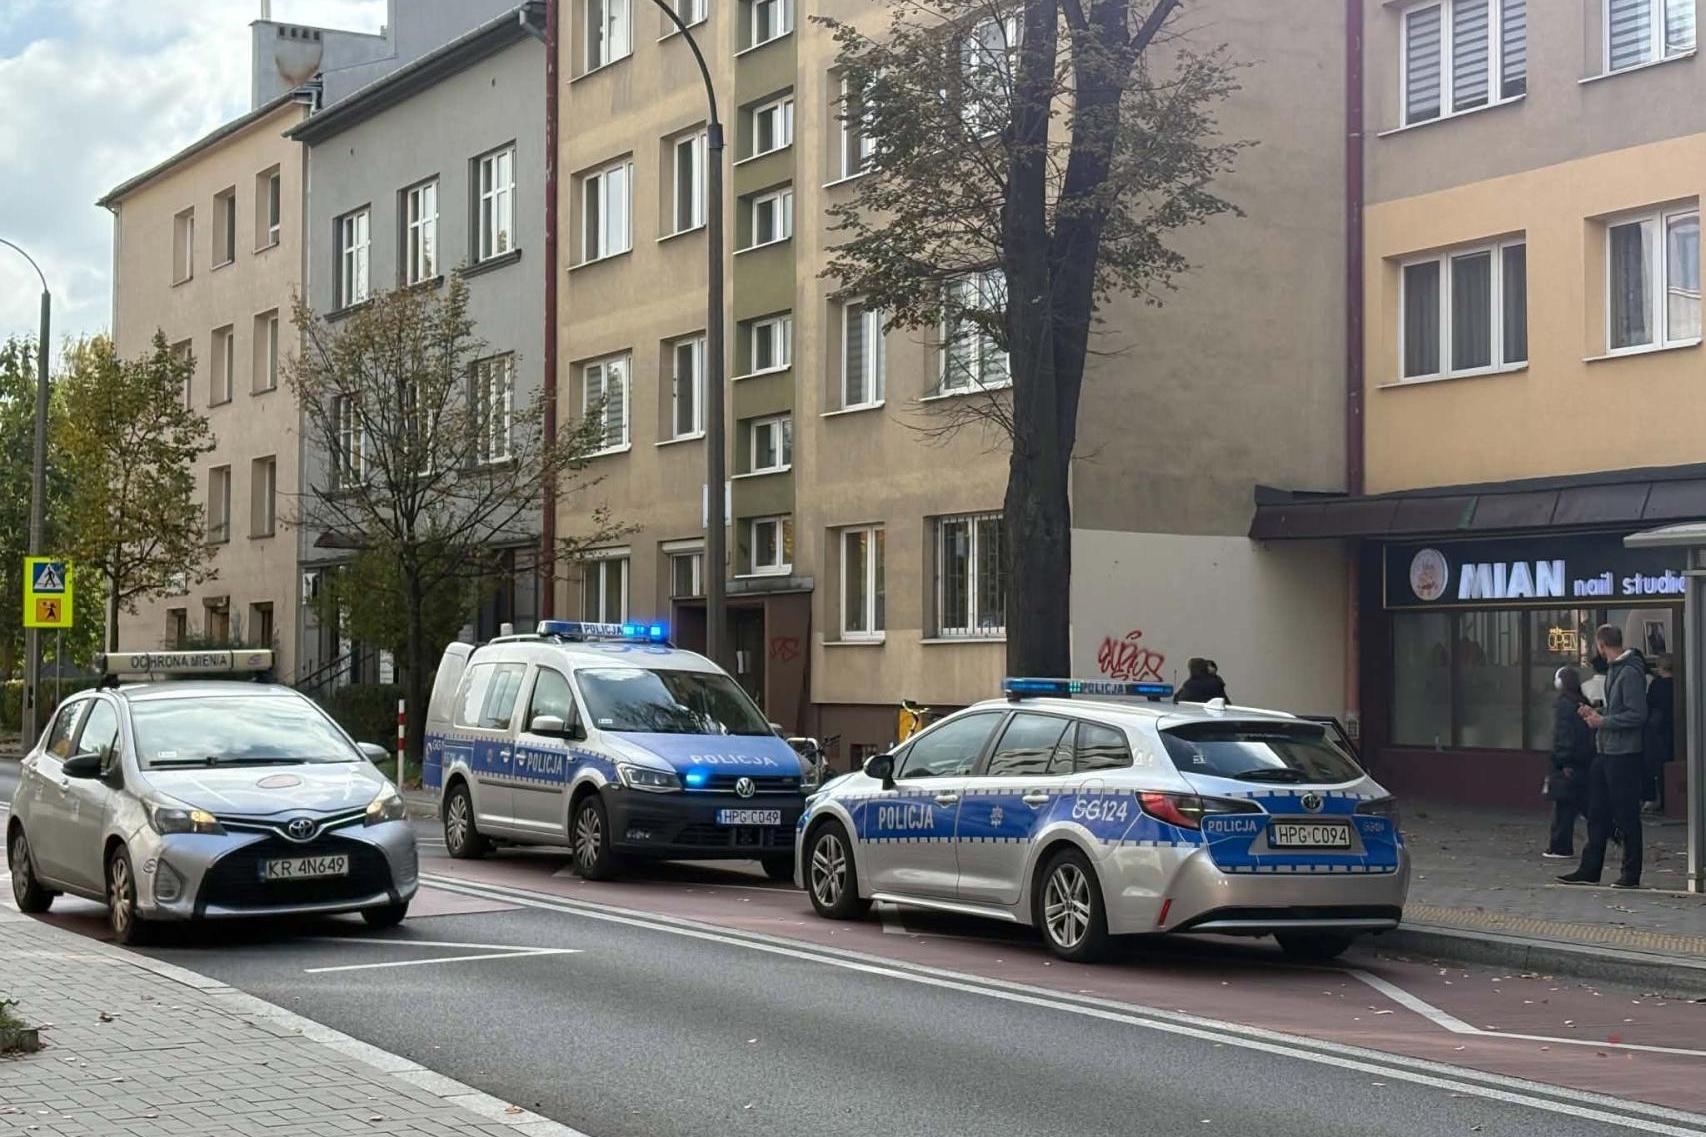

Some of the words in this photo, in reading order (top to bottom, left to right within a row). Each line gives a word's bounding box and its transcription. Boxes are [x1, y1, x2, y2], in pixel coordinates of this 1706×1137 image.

[1458, 559, 1565, 600] MIAN
[1573, 571, 1614, 597] nail
[582, 623, 624, 635] POLICJA
[1548, 634, 1577, 650] OPEN
[130, 655, 190, 670] OCHRONA
[1081, 682, 1124, 695] POLICJA
[526, 751, 563, 774] POLICJA
[689, 754, 778, 767] POLICJA
[724, 810, 748, 824] HPG
[879, 804, 934, 830] POLICJA
[1207, 819, 1258, 833] POLICJA
[1278, 826, 1308, 844] HPG
[1312, 827, 1348, 844] C094
[268, 860, 293, 878] KR
[298, 856, 345, 875] 4N649
